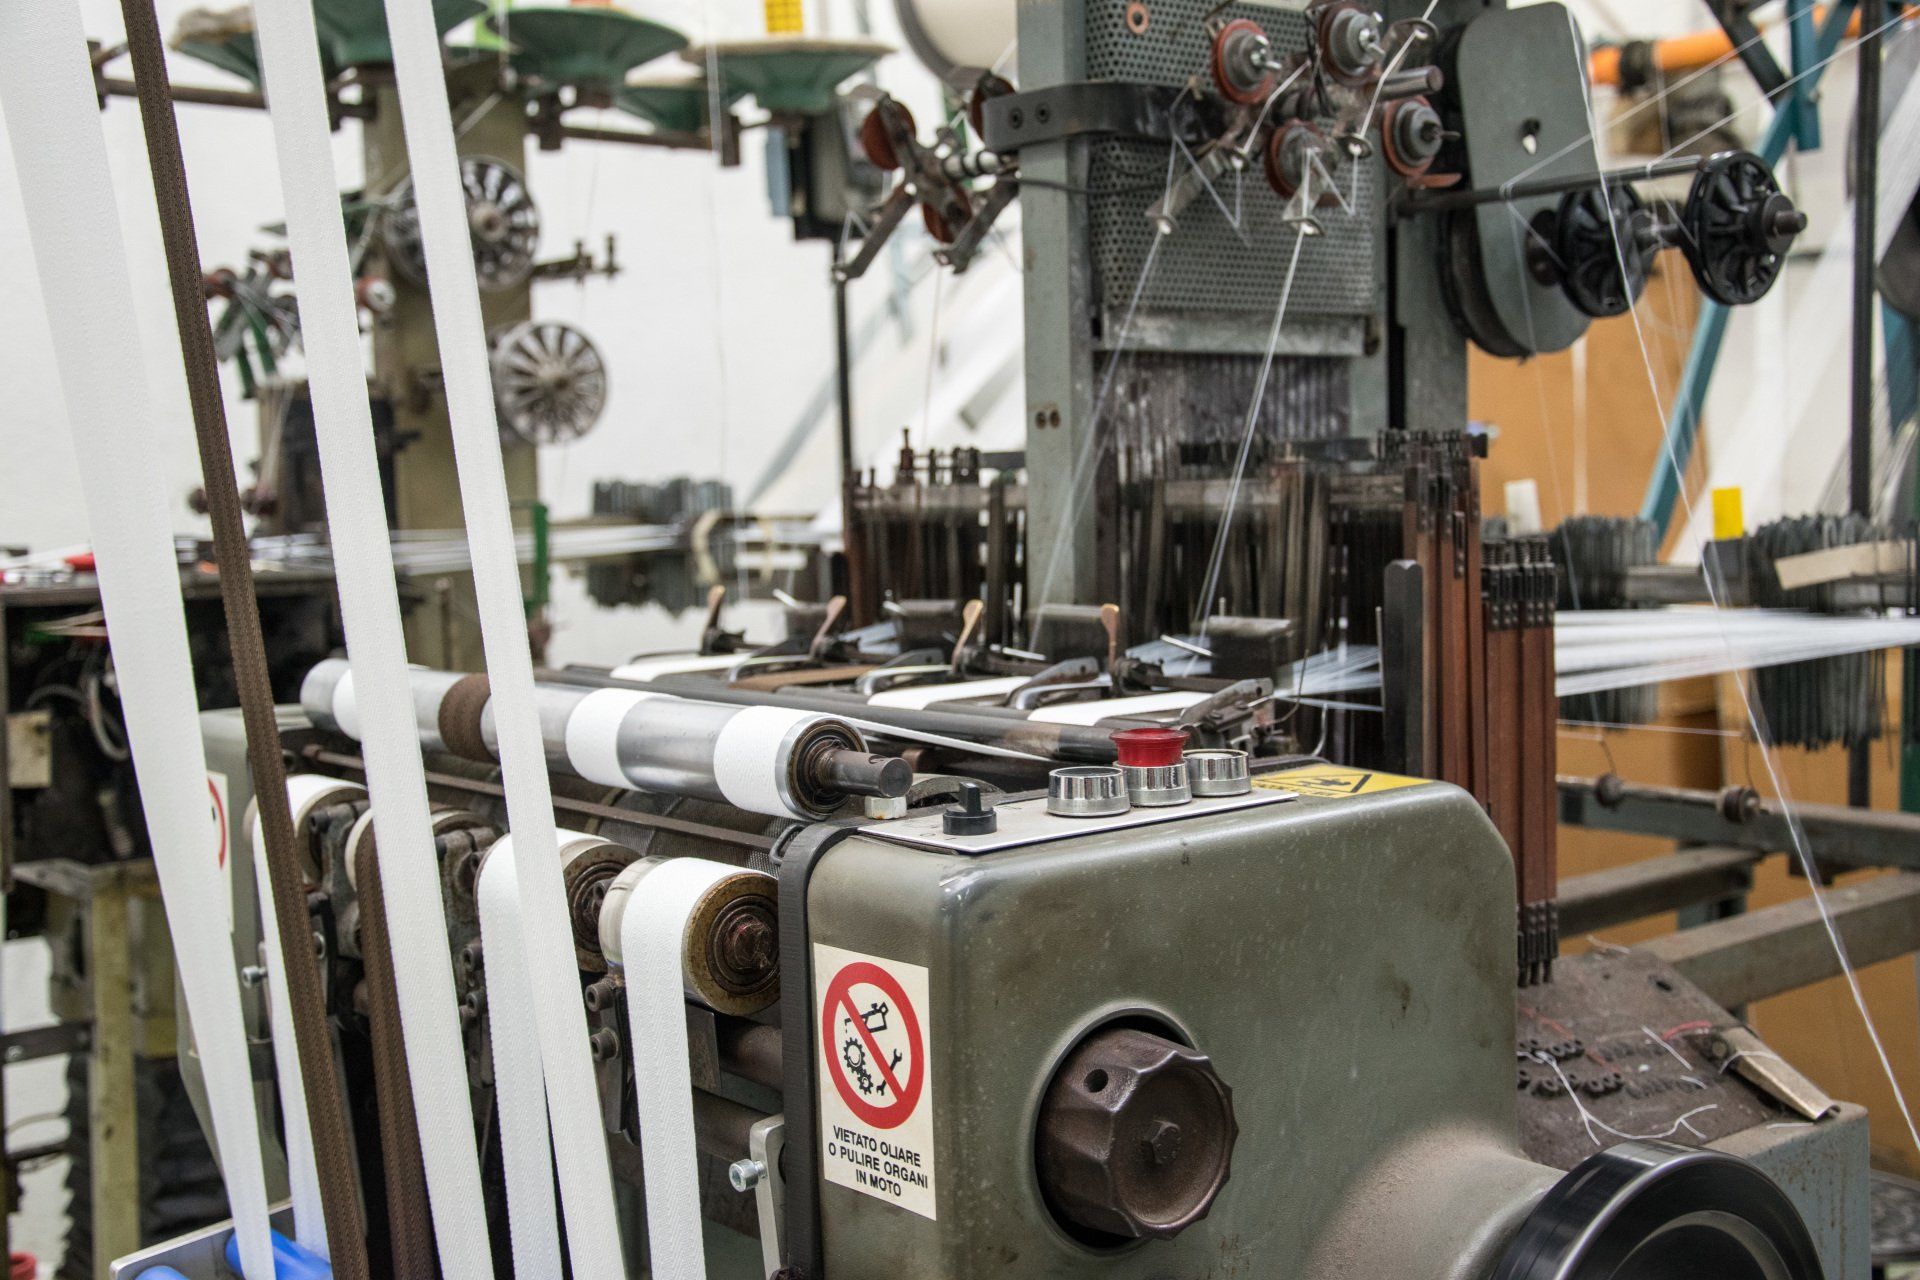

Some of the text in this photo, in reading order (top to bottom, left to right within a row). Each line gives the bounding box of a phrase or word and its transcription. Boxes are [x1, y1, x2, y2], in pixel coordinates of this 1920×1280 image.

[828, 1142, 928, 1189] O PULIRE ORGANI
[833, 1125, 921, 1168] VIETATO OLIARE
[855, 1169, 902, 1197] IN MOTO
